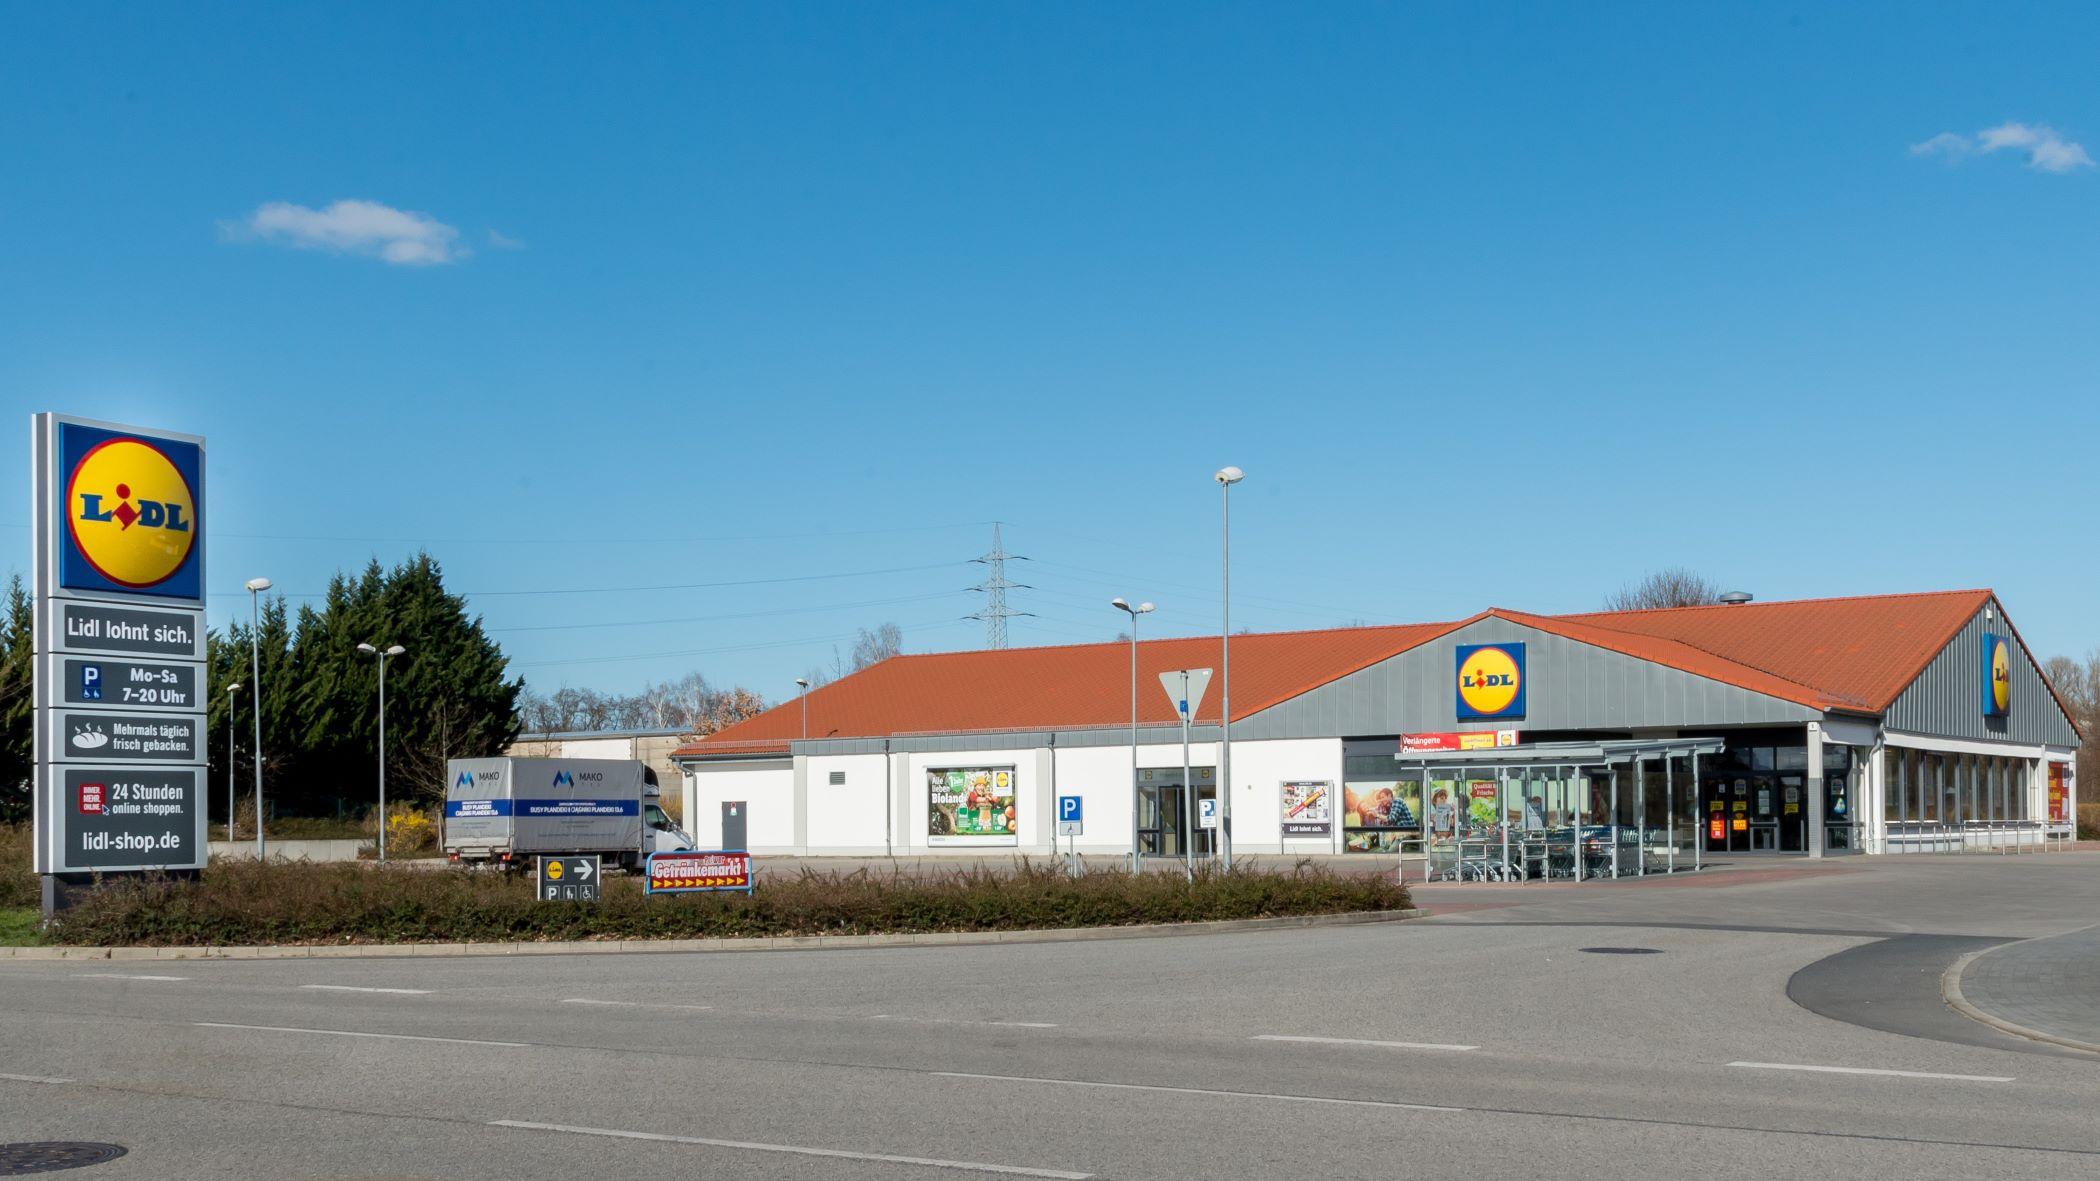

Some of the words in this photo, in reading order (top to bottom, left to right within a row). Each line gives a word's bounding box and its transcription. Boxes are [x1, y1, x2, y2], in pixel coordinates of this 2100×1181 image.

[68, 617, 100, 638] Lidl
[106, 620, 150, 641] lohnt
[154, 624, 192, 644] sich.
[84, 667, 98, 685] P
[160, 689, 186, 704] Uhr
[113, 723, 158, 737] Mehrmals
[160, 725, 190, 739] täglich
[112, 738, 141, 751] frisch
[143, 740, 190, 753] gebacken.
[1402, 736, 1441, 746] Verlängerte
[479, 771, 500, 781] MAKO
[579, 773, 603, 781] MAKO
[112, 783, 129, 800] 24
[132, 783, 183, 800] Stunden
[931, 793, 965, 804] Bioland
[112, 802, 141, 814] online
[143, 802, 184, 816] shoppen.
[1064, 799, 1077, 819] P
[82, 831, 181, 853] lidl-shop.de
[655, 860, 742, 878] Getränkemarkt
